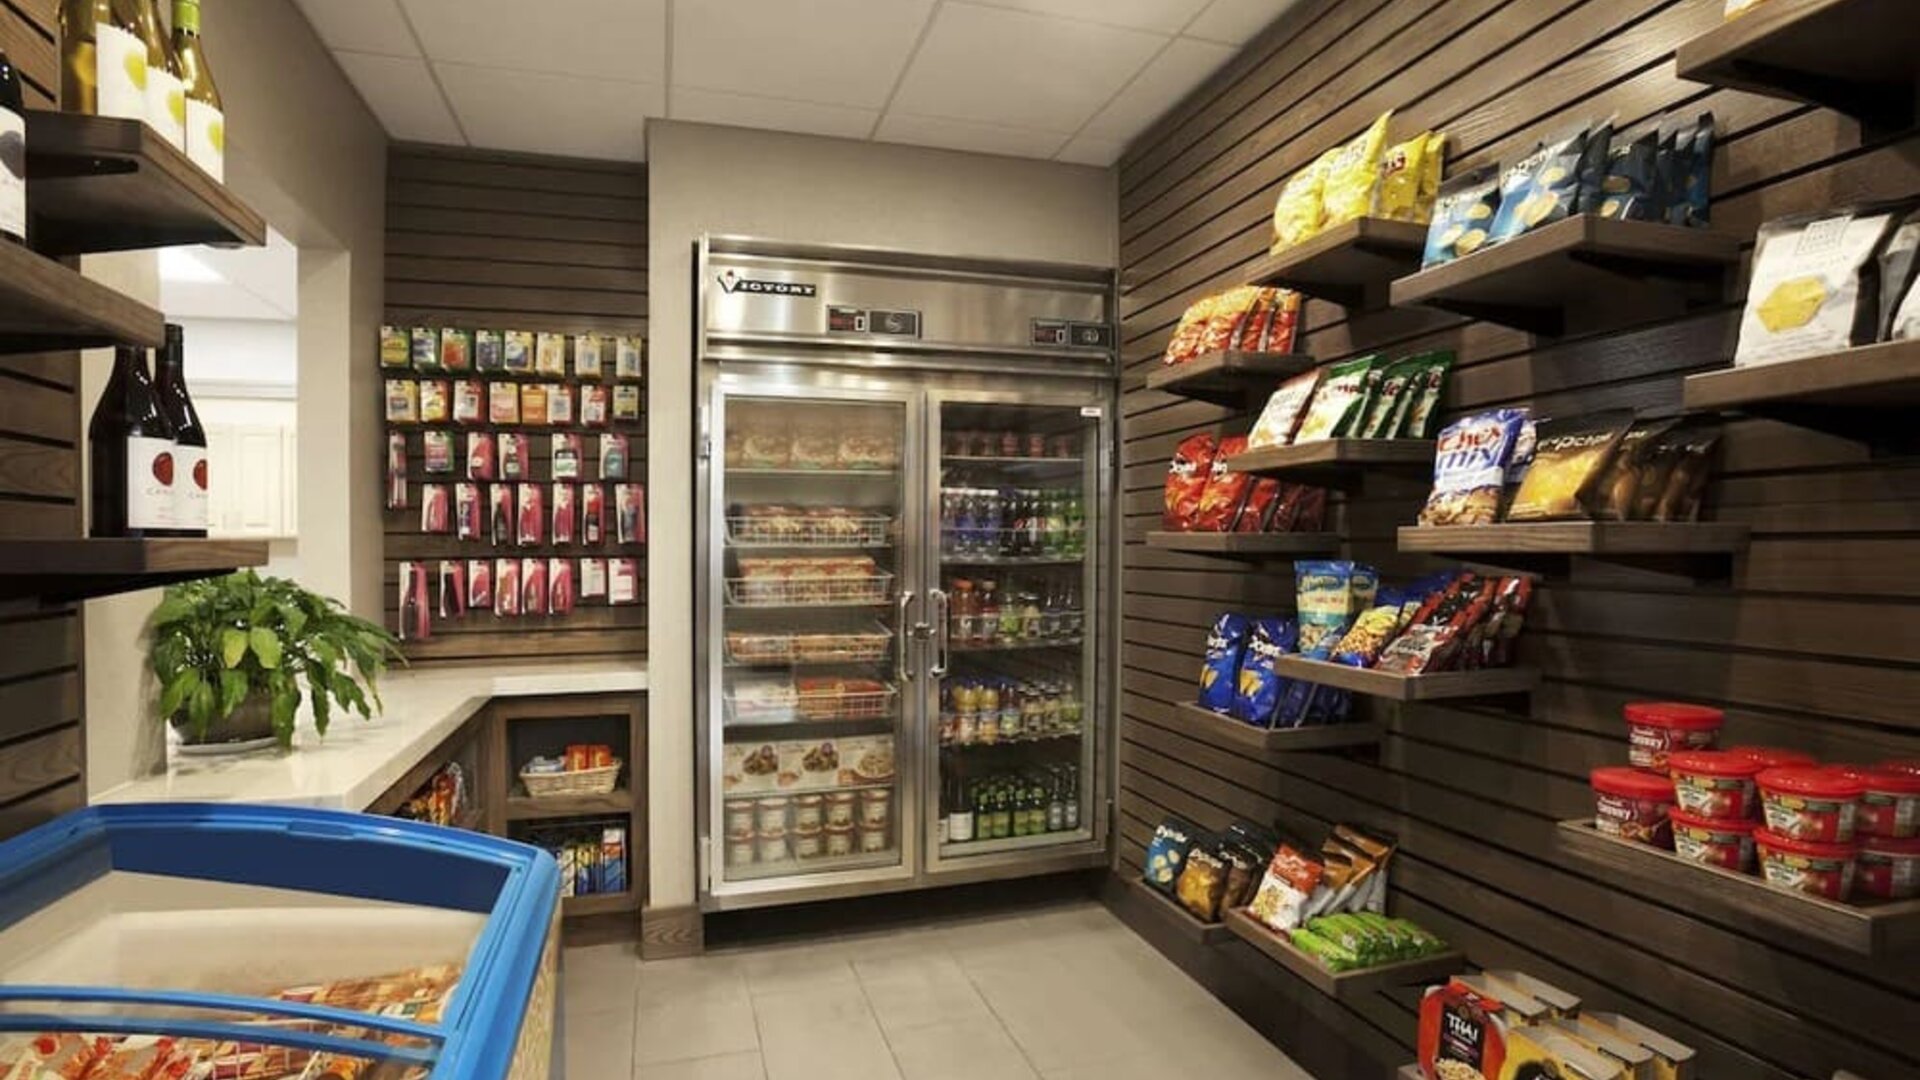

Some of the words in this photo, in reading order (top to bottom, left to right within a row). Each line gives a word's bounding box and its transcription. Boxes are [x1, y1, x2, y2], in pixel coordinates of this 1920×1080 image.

[717, 272, 815, 296] VICTORY
[1436, 426, 1501, 452] Chex
[1445, 1012, 1478, 1043] THAI
